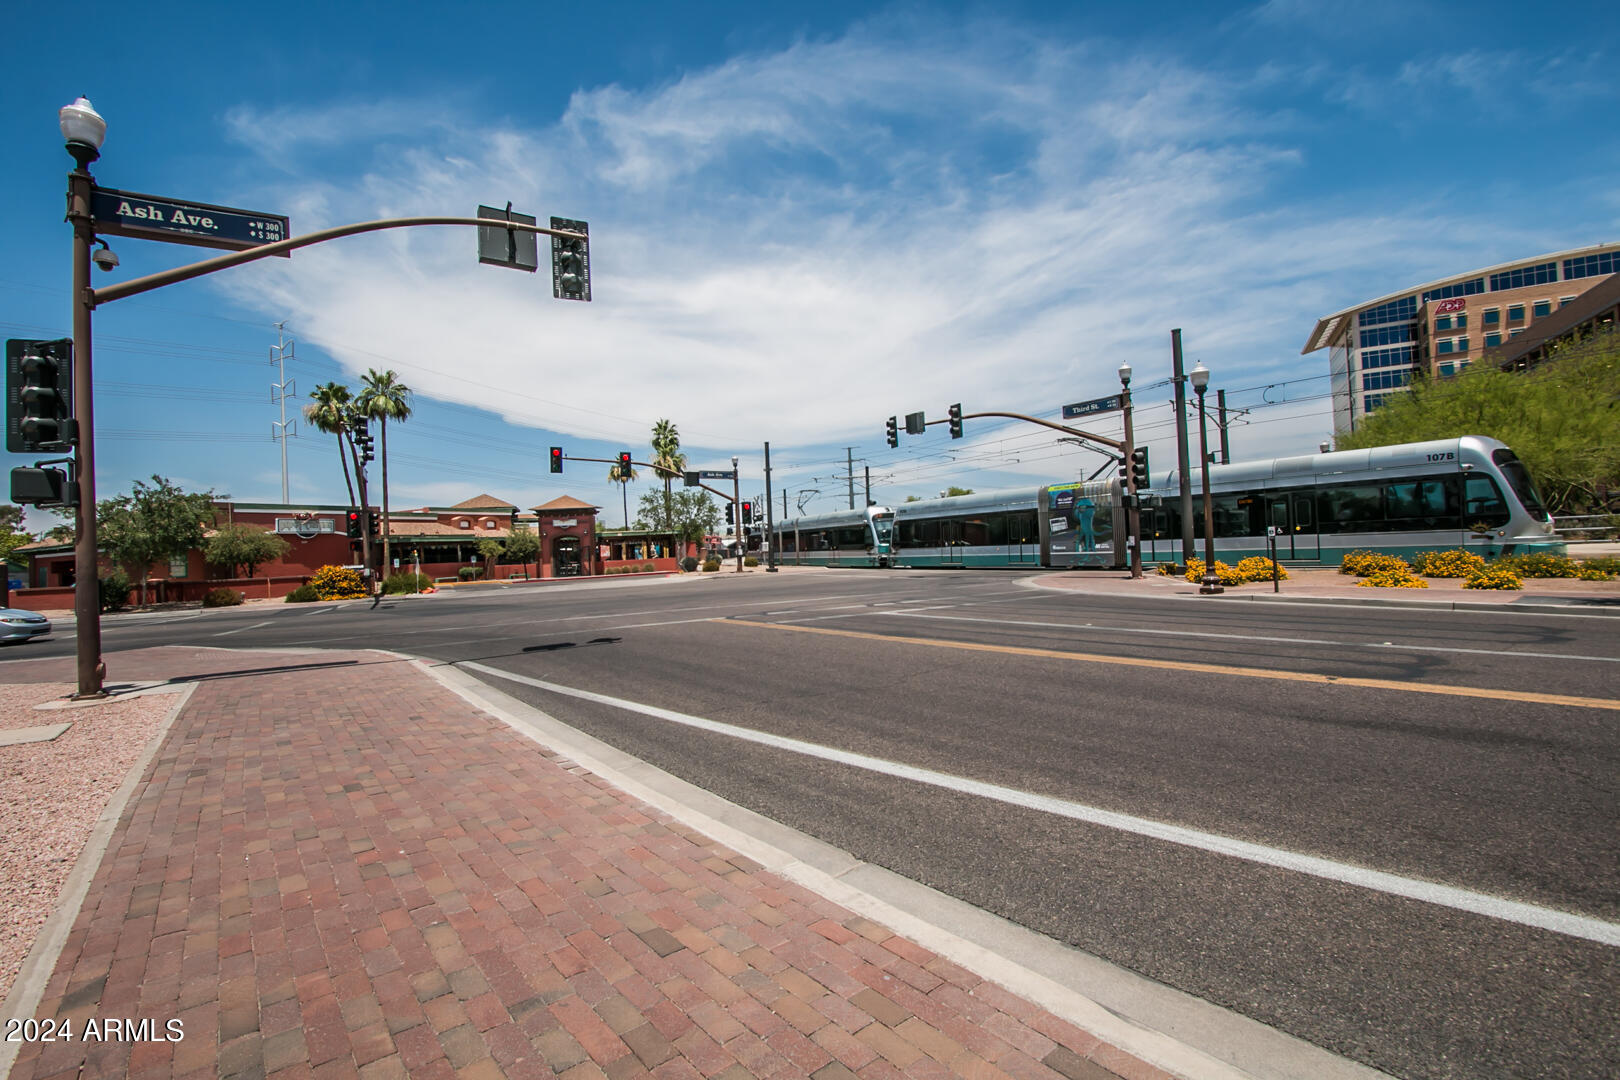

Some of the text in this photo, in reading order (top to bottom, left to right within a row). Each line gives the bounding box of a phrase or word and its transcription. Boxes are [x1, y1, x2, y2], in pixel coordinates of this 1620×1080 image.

[116, 202, 219, 230] Ash Ave.
[256, 221, 279, 232] W 300
[258, 231, 280, 241] S 300
[1435, 298, 1465, 315] ADP
[1072, 405, 1090, 413] Third
